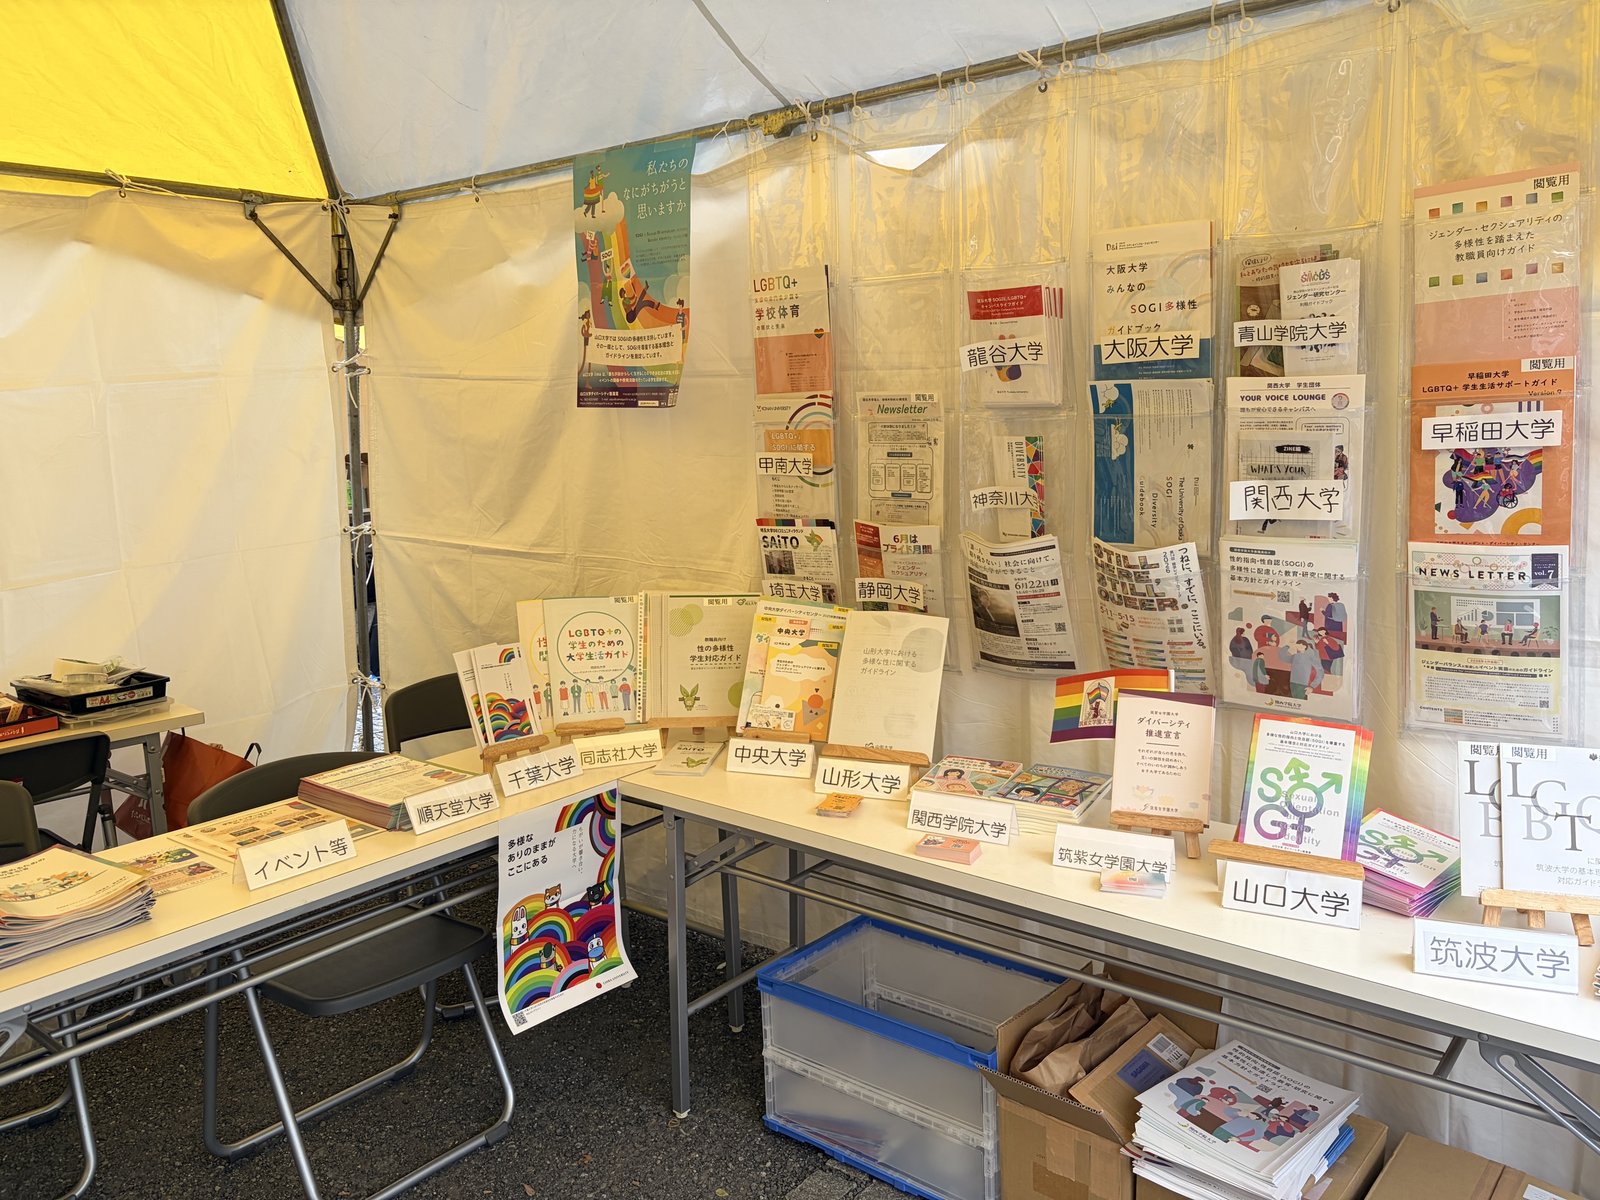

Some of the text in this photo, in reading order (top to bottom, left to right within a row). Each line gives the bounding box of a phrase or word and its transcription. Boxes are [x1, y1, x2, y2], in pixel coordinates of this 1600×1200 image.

[647, 157, 689, 176] 私たちの
[623, 178, 687, 201] なにがちがうと
[1533, 174, 1570, 190] 閲覧用
[637, 200, 687, 220] 思いますか
[1428, 213, 1563, 240] ジェンダー・セクシュアリティの
[1454, 231, 1535, 250] 多様性を踏まえた
[1455, 243, 1536, 263] 教職員向けガイド
[1106, 262, 1148, 275] 大阪大学
[753, 275, 798, 292] LGBTQ+
[1106, 282, 1146, 294] みんなの
[1286, 289, 1347, 300] ジェンダー研究センター
[755, 304, 800, 321] 学校体育
[1238, 321, 1347, 343] 青山学院大学
[967, 341, 1043, 367] 龍谷大学
[1104, 334, 1193, 360] 大阪大学
[1529, 358, 1565, 370] 閲覧用
[1467, 370, 1510, 380] 早稲田大学
[1422, 378, 1558, 393] LGBTQ+ 学生生活サポートガイド
[1240, 394, 1262, 402] YOUR
[1292, 393, 1326, 401] LOUNGE
[877, 404, 928, 414] Newsletter
[1431, 418, 1555, 443] 早稲田大学
[758, 457, 812, 475] 甲南大学
[1014, 441, 1026, 479] DIVERSITY
[1244, 485, 1340, 513] 関西大学
[1150, 492, 1158, 528] Diversity
[893, 534, 918, 544] 6月は
[1230, 575, 1302, 587] 基本方針とガイドライン
[1419, 567, 1527, 580] NEWS LETTER
[1547, 570, 1554, 580] 7
[769, 582, 821, 602] 埼玉大学
[858, 582, 921, 604] 静岡大学
[568, 628, 622, 638] LGBTQ+の
[777, 627, 806, 636] 中央大学
[568, 640, 624, 650] 学生のための
[697, 644, 734, 653] 性の多様性
[863, 648, 918, 658] 山形大学における
[566, 650, 629, 661] 大学生活ガイド
[689, 654, 741, 662] 学生対応ガイド
[862, 658, 917, 668] 多様な性に関する
[860, 667, 897, 676] ガイドライン
[1137, 716, 1191, 729] ダイバーシティ
[1145, 729, 1182, 739] 推進宣言
[580, 743, 658, 766] 同志社大学
[734, 745, 807, 767] 中央大学
[1511, 746, 1548, 760] 閲覧用
[507, 755, 576, 790] 千葉大学
[822, 767, 901, 795] 山形大学
[416, 791, 495, 825] 順天堂大学
[911, 809, 1007, 839] 関西学院大学
[507, 833, 534, 850] 多様な
[507, 837, 556, 863] ありのままが
[254, 837, 348, 880] イベント等
[507, 855, 548, 877] ここにある
[1058, 847, 1168, 874] 筑紫女学園大学
[1233, 878, 1349, 917] 山口大学
[1430, 936, 1570, 979] 筑波大学
